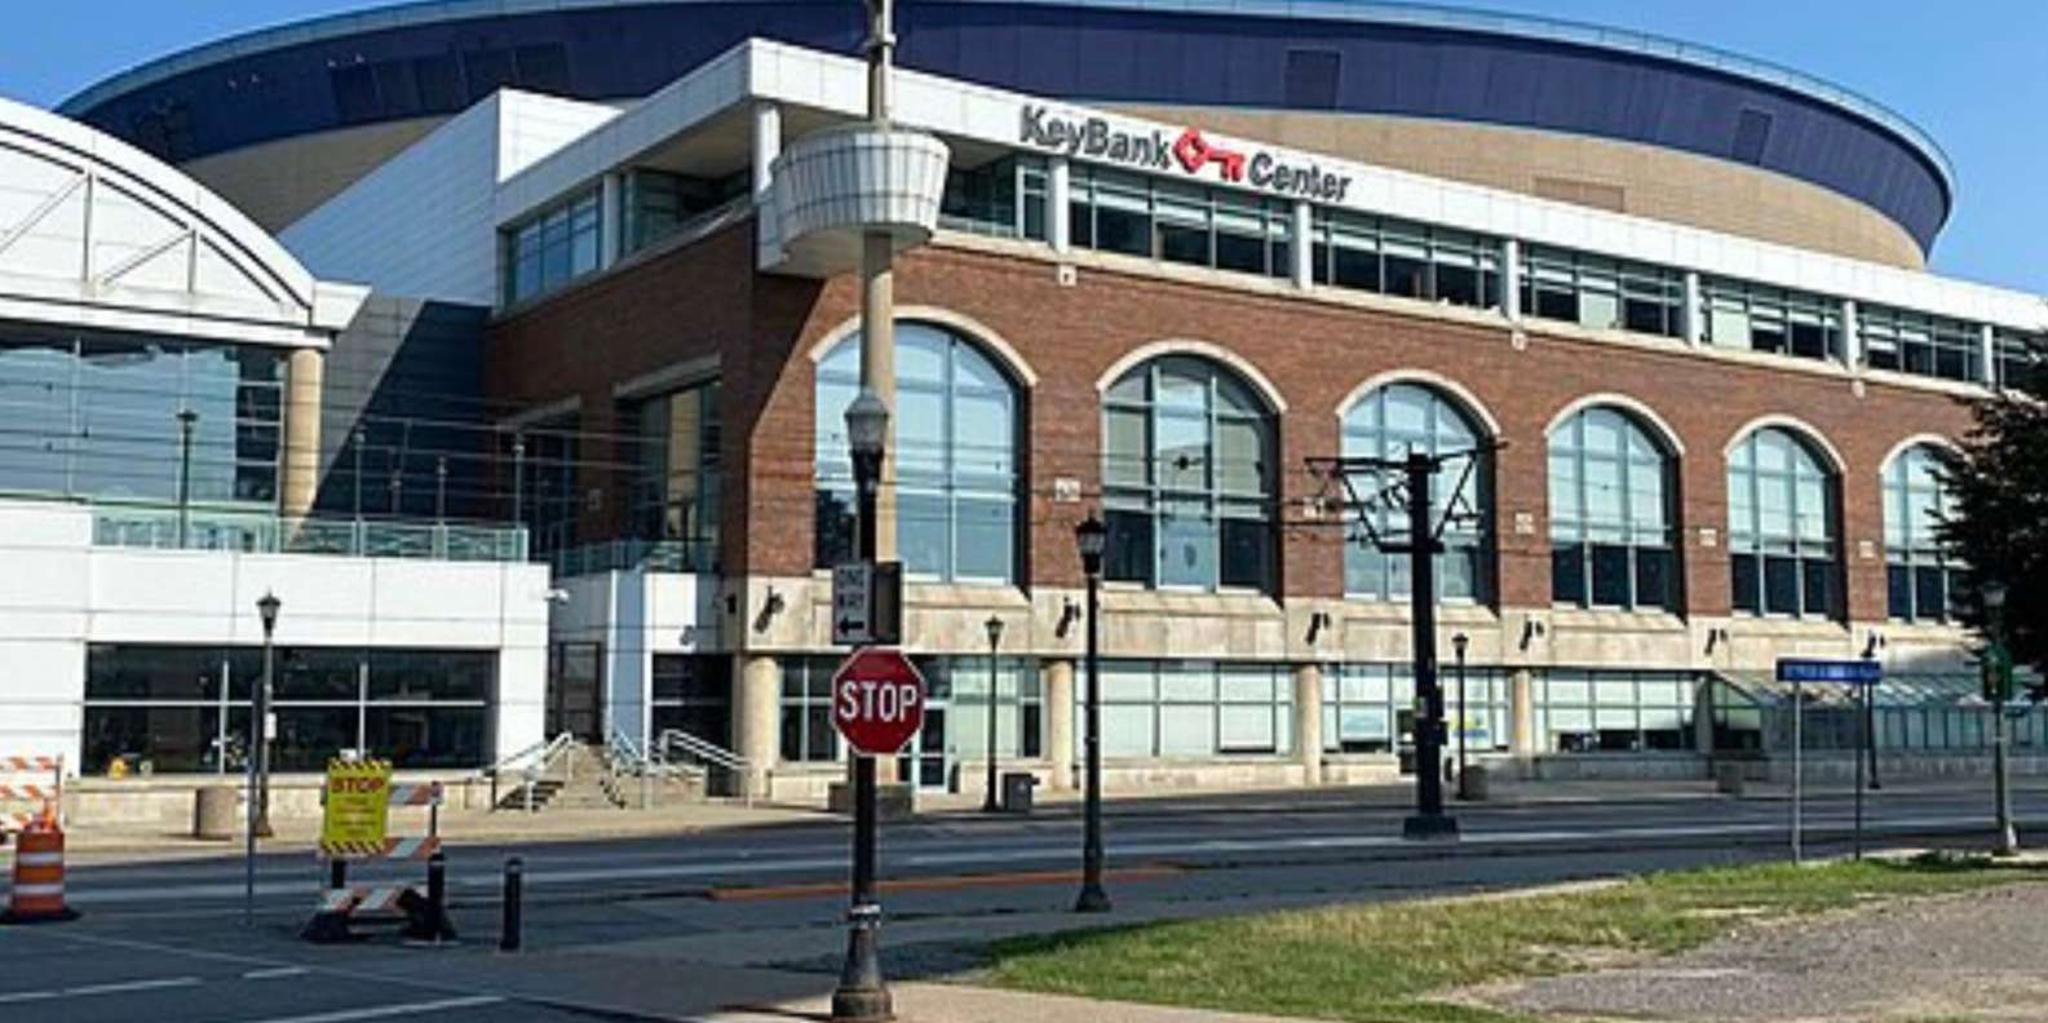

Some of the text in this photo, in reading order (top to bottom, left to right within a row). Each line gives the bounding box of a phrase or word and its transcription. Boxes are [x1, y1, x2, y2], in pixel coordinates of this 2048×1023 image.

[1020, 105, 1352, 201] KeyBank Center
[838, 681, 918, 722] STOP
[331, 777, 384, 794] STOP
